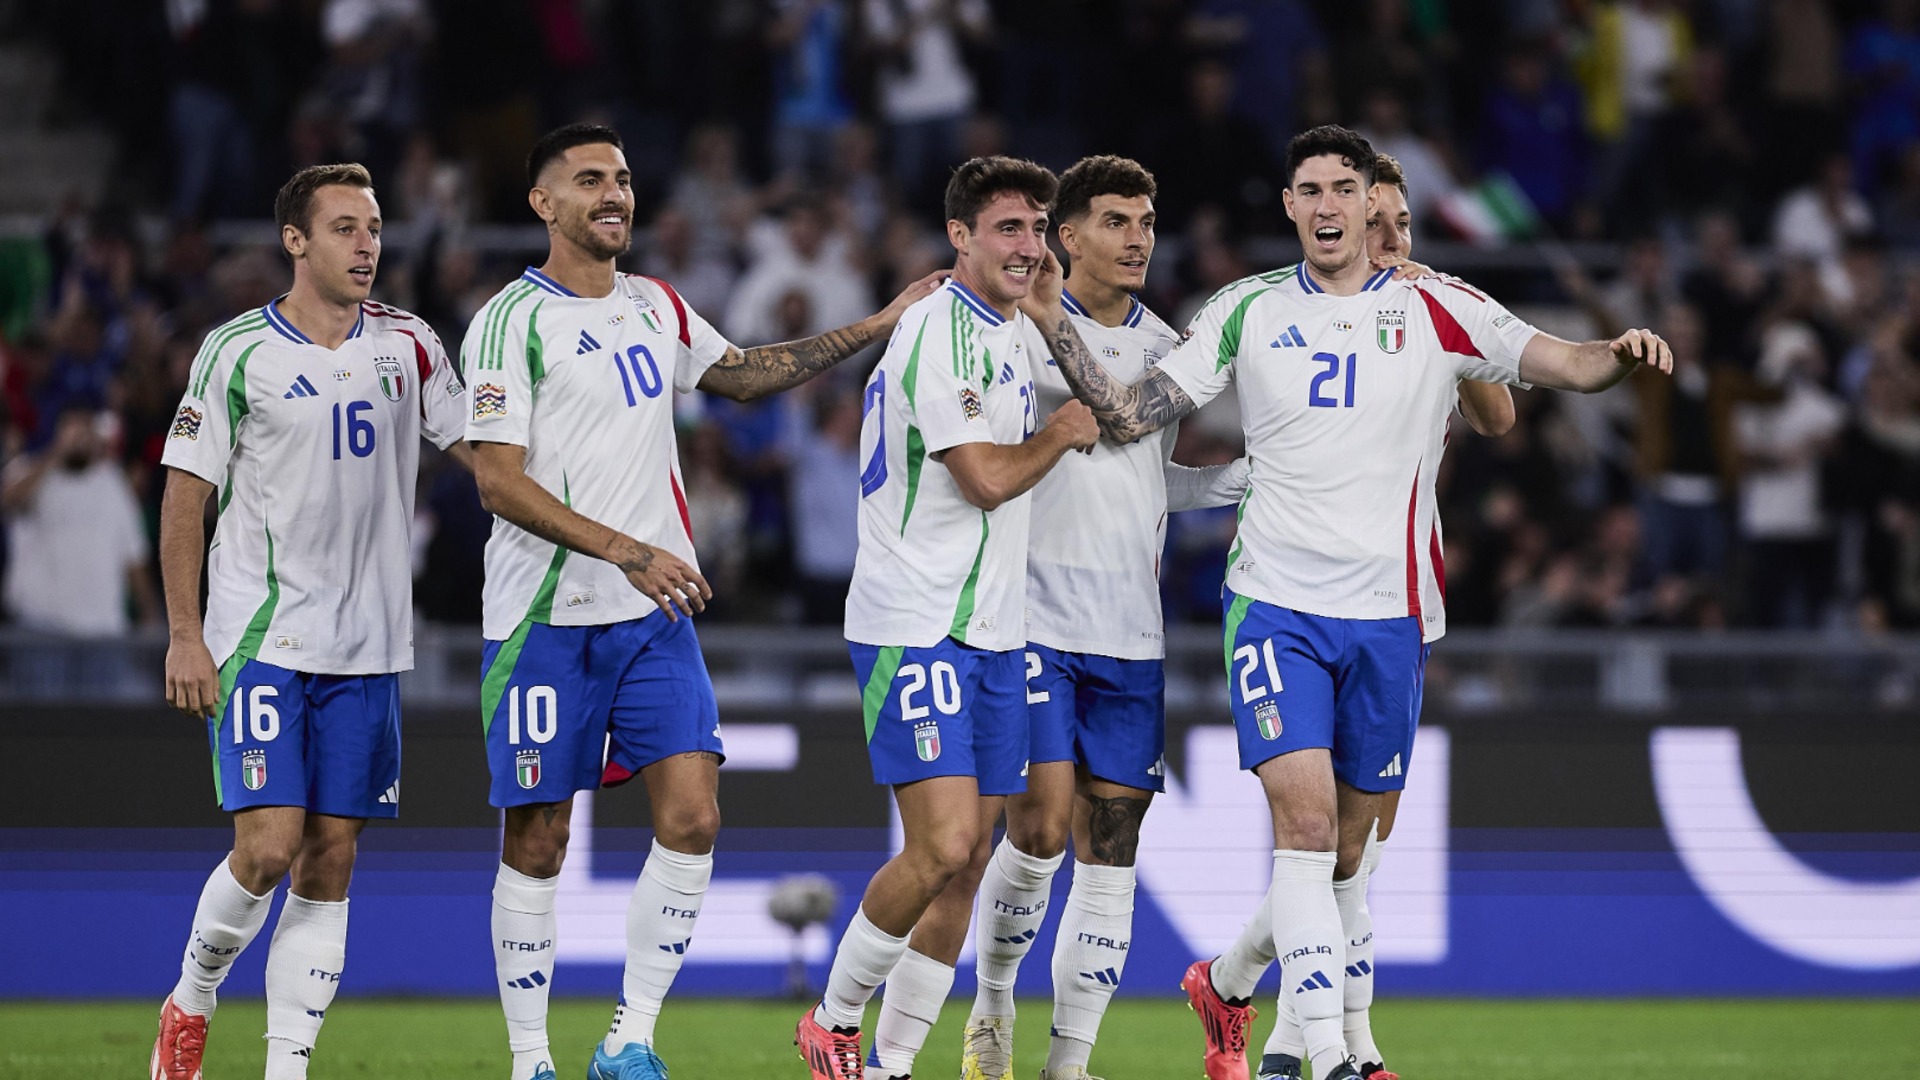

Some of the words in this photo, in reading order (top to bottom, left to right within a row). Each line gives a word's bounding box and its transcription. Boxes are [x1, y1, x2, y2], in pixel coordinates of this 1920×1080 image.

[1378, 318, 1404, 327] ITALIA
[613, 344, 663, 407] 10
[1309, 352, 1357, 407] 21
[332, 400, 375, 460] 16
[1233, 637, 1284, 705] 21
[897, 660, 962, 721] 20
[233, 685, 280, 744] 16
[509, 685, 557, 744] 10
[916, 729, 937, 739] ITALIA
[518, 757, 538, 766] ITALIA
[994, 899, 1046, 916] ITALIA
[502, 939, 552, 952] ITALIA
[1078, 932, 1130, 952] ITALIA
[1282, 945, 1332, 965] ITALIA
